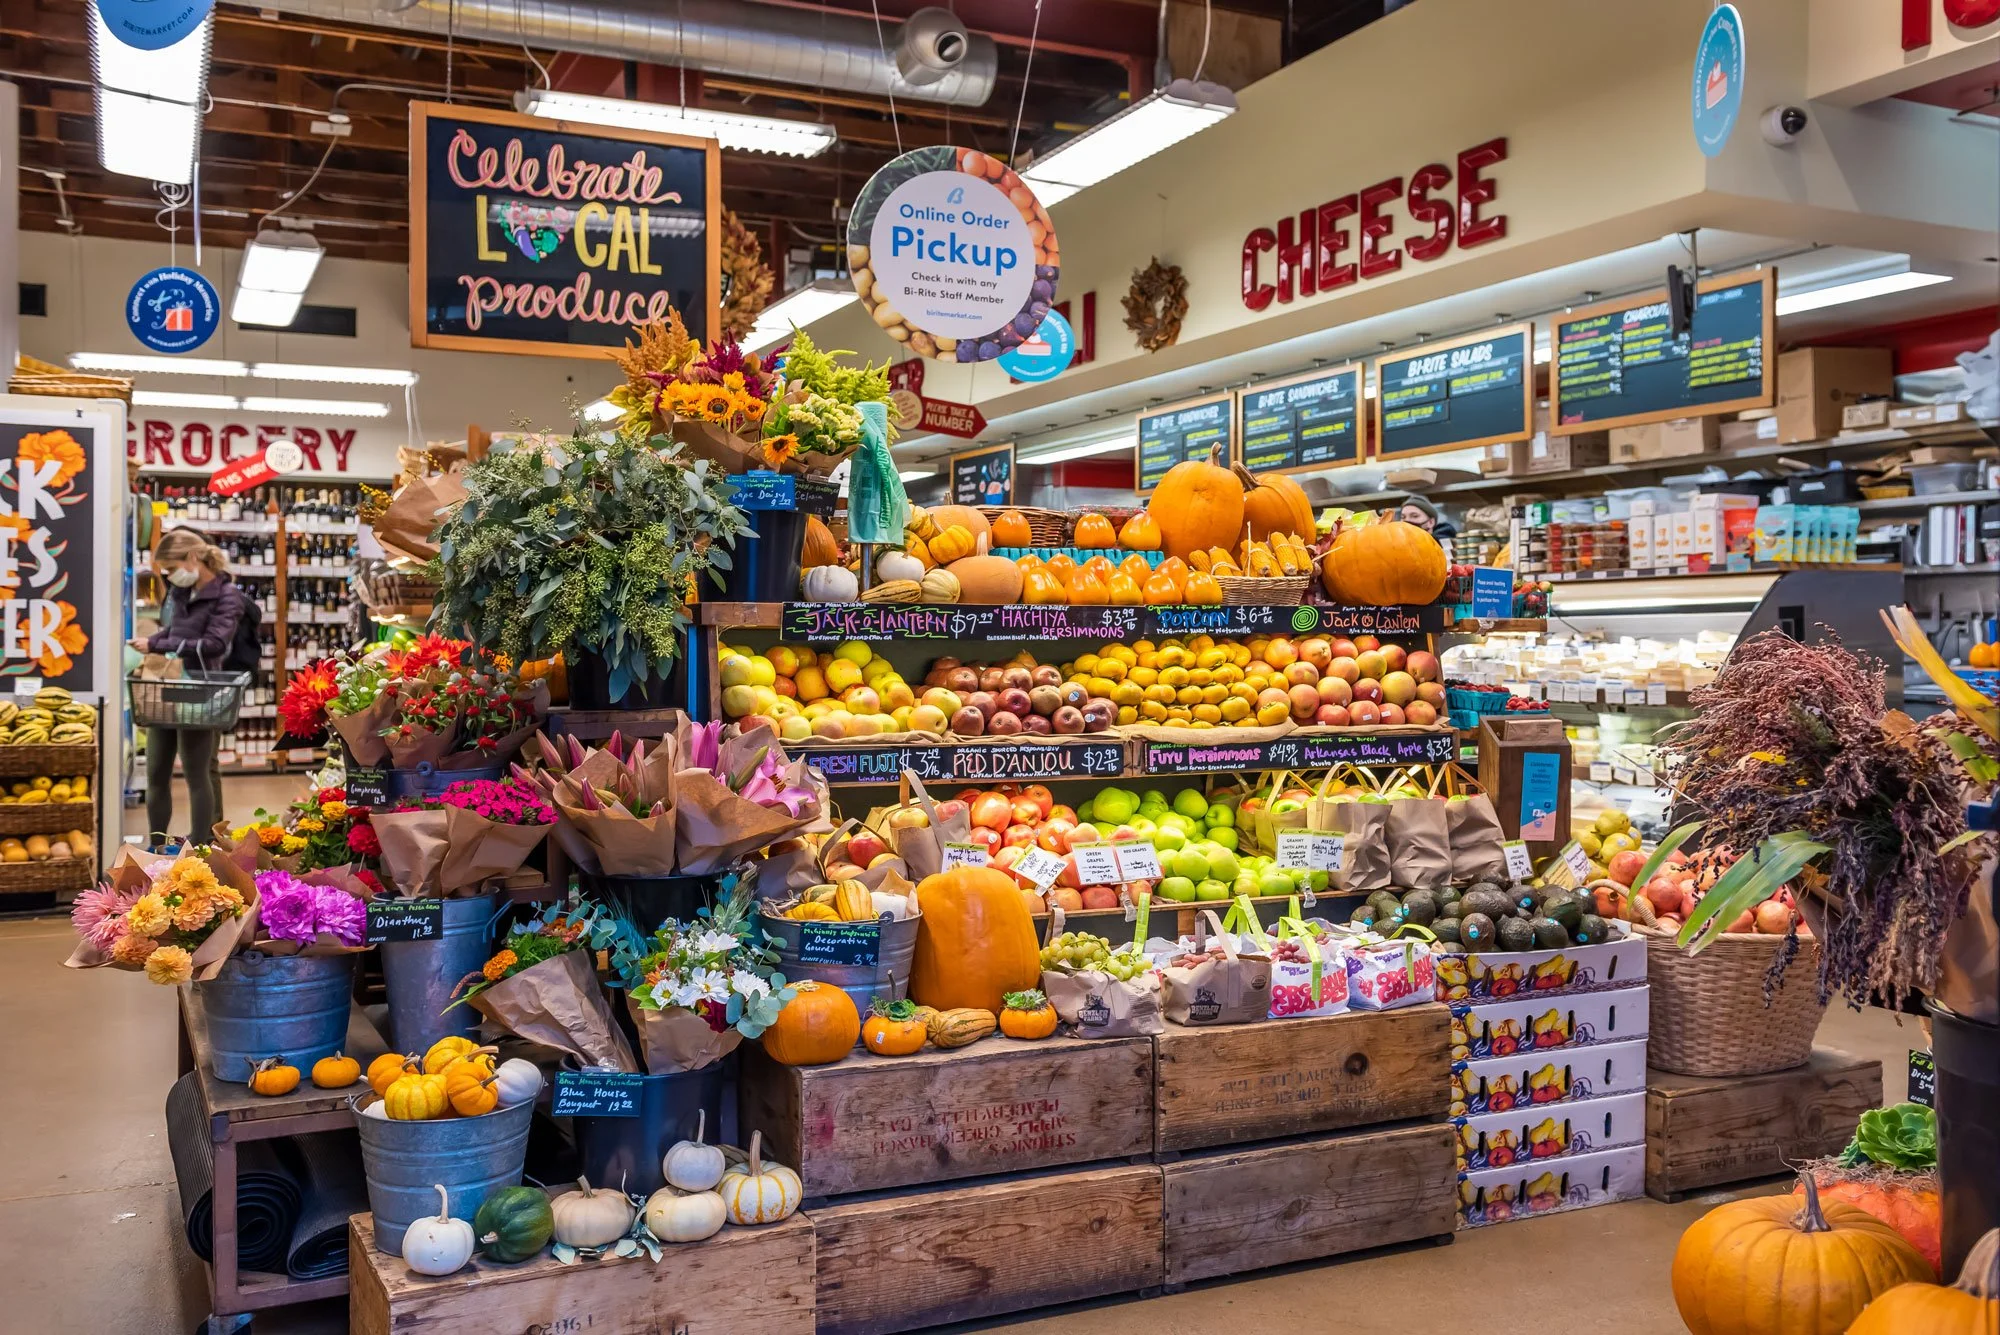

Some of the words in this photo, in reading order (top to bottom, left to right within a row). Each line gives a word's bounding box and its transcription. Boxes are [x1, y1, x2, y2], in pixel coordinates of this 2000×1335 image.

[447, 128, 682, 204] Celebrate
[900, 204, 956, 223] Online
[962, 211, 1010, 229] Order
[1242, 137, 1509, 311] CHEESE
[892, 226, 1017, 276] Pickup
[911, 272, 941, 283] Check
[944, 274, 954, 284] in
[956, 275, 977, 287] with
[980, 279, 998, 290] any
[458, 271, 672, 331] produce
[904, 287, 937, 298] Bi-Rite
[940, 290, 962, 300] Staff
[965, 292, 1004, 304] Member
[926, 309, 982, 321] biritemarket.com
[1408, 354, 1448, 378] BI-RITE
[1451, 344, 1493, 368] SALADS
[1287, 379, 1340, 402] SANDWICHES
[925, 413, 974, 433] NUMBER
[968, 410, 976, 419] A
[214, 472, 243, 491] THIS
[242, 460, 268, 479] WAY
[758, 489, 786, 503] Daisy
[805, 608, 947, 635] JACK-O-LANTERN
[950, 609, 994, 640] $9.99
[1002, 610, 1067, 628] HACHIYA
[1158, 607, 1231, 628] POPCORN
[1042, 622, 1125, 639] PERSIMMONS
[1188, 746, 1261, 765] Persimmons
[1304, 746, 1357, 760] Arkansas
[1361, 744, 1391, 756] Black
[1398, 742, 1423, 755] Apple
[809, 755, 857, 774] FRESH
[860, 752, 900, 774] FUJI
[954, 753, 987, 776] RED
[992, 751, 1075, 774] D'ANJOU
[376, 915, 430, 928] Dianthus
[805, 942, 835, 952] Gourds
[814, 935, 868, 945] Decorative
[1911, 1069, 1934, 1082] Dried
[560, 1087, 586, 1097] Blue
[594, 1088, 629, 1098] House
[558, 1099, 602, 1112] Bouquet
